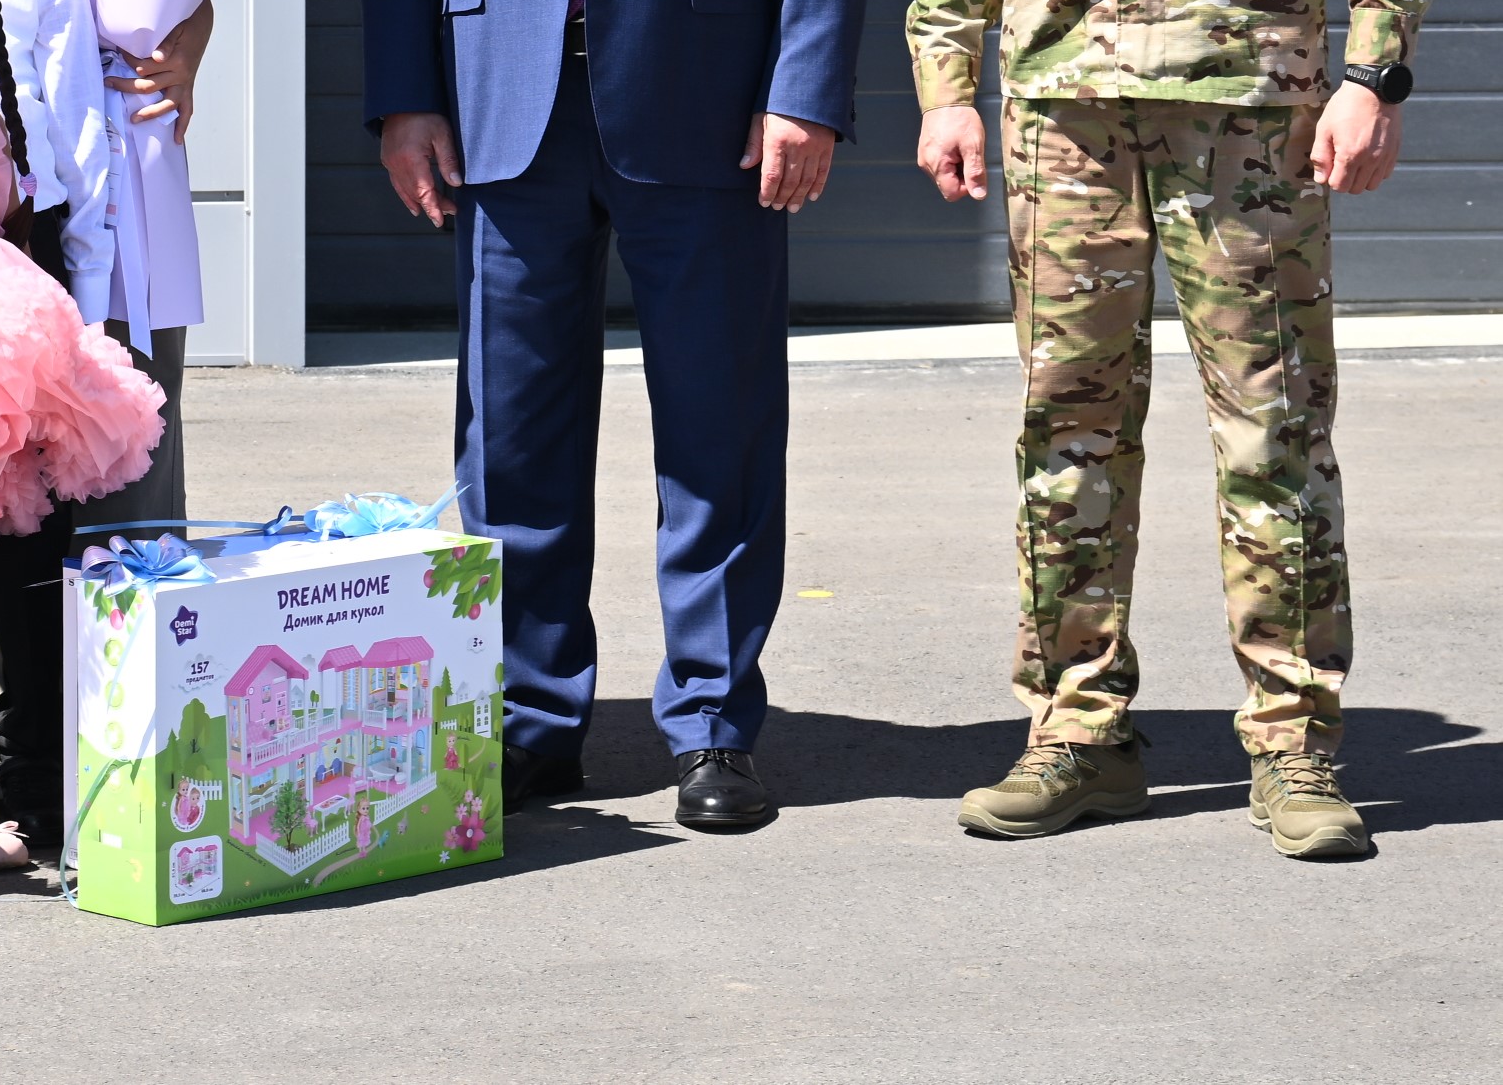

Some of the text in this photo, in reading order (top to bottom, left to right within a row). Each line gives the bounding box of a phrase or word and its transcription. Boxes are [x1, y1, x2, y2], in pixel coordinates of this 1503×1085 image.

[277, 574, 391, 610] DREAM HOME
[174, 615, 195, 629] Demi
[283, 605, 385, 633] Домик для кукол
[177, 627, 193, 636] Star
[473, 637, 483, 647] 3+
[190, 660, 210, 675] 157
